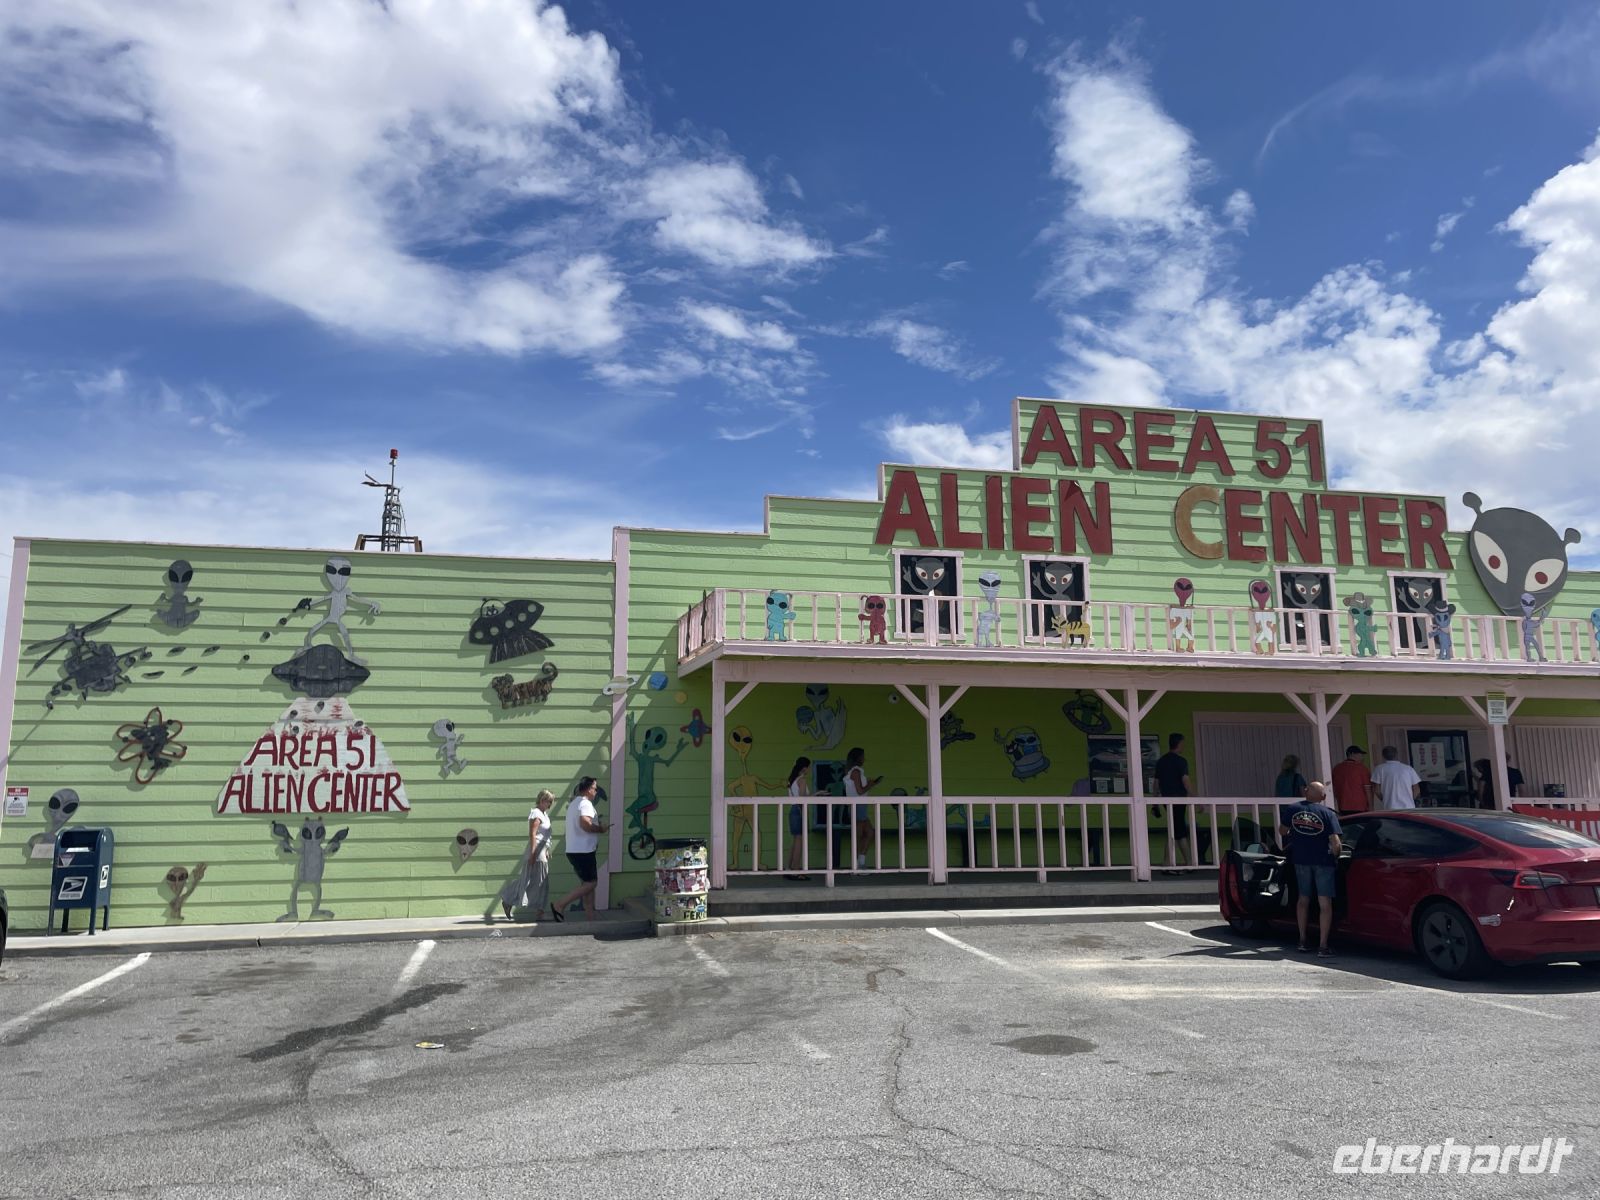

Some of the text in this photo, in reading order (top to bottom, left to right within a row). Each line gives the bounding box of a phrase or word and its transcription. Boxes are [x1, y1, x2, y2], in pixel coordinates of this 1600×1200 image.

[1022, 406, 1323, 482] AREA 51
[876, 470, 1453, 570] ALIEN CENTER
[244, 734, 376, 771] AREA 51
[218, 772, 411, 813] ALIEN CENTER
